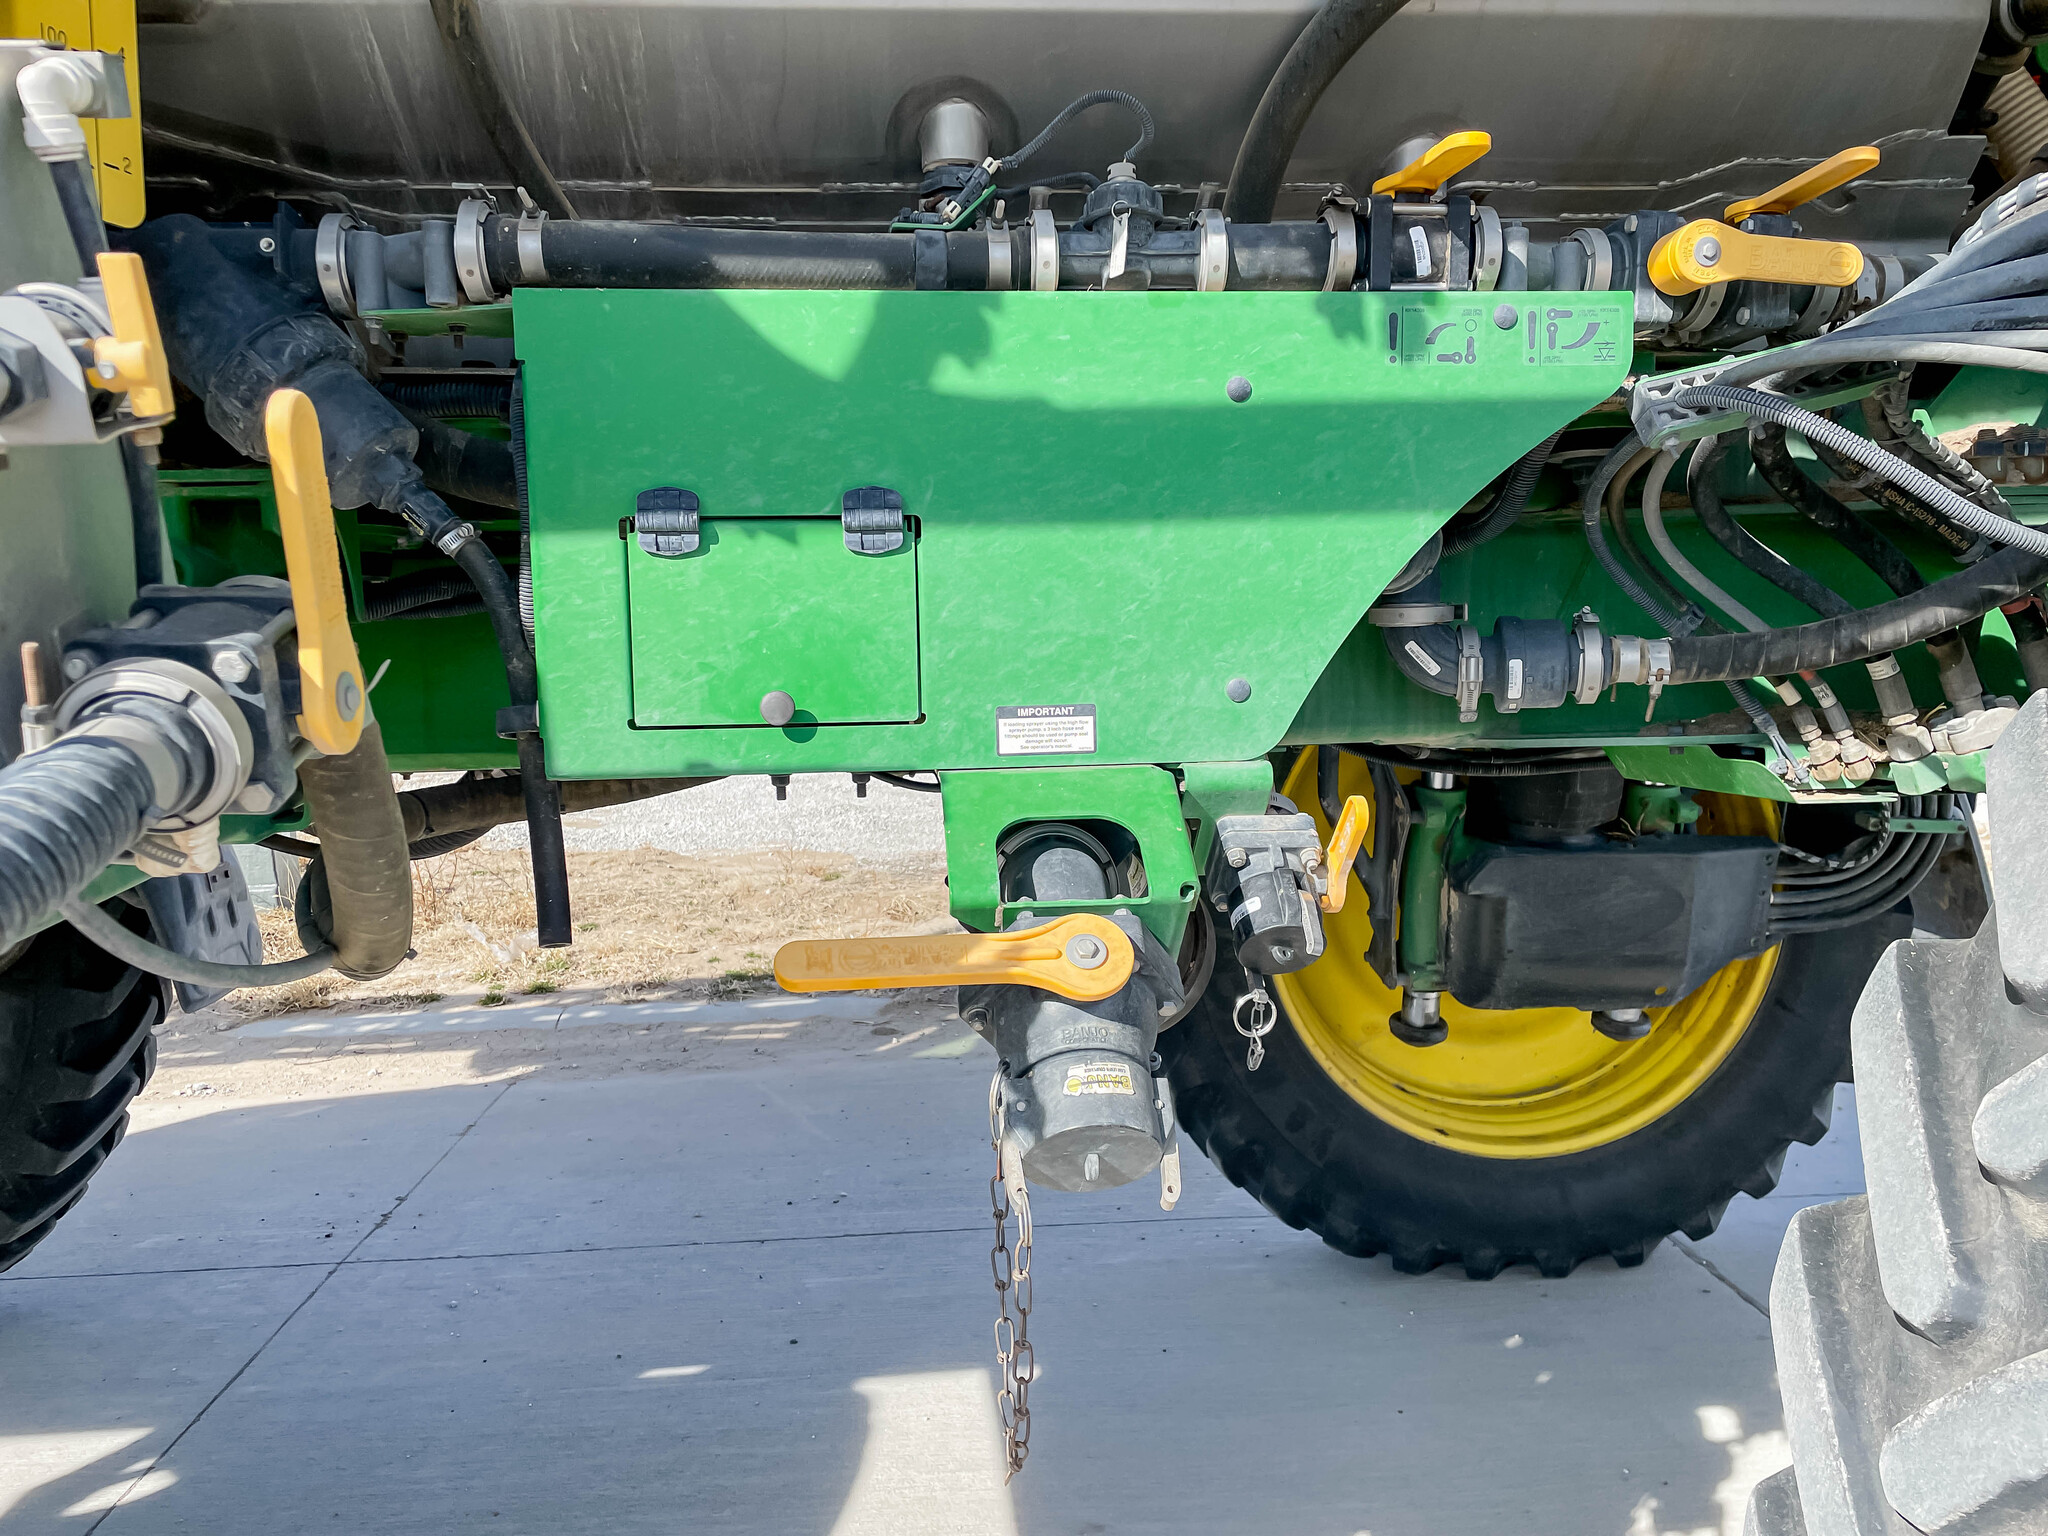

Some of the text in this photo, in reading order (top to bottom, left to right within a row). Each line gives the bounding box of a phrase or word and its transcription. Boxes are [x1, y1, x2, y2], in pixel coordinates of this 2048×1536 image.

[122, 156, 133, 175] 2
[1884, 488, 1906, 507] MSHA
[1937, 524, 1962, 544] MADE
[1959, 540, 1971, 551] IN
[1017, 706, 1075, 717] IMPORTANT
[1062, 1025, 1109, 1040] BANJO
